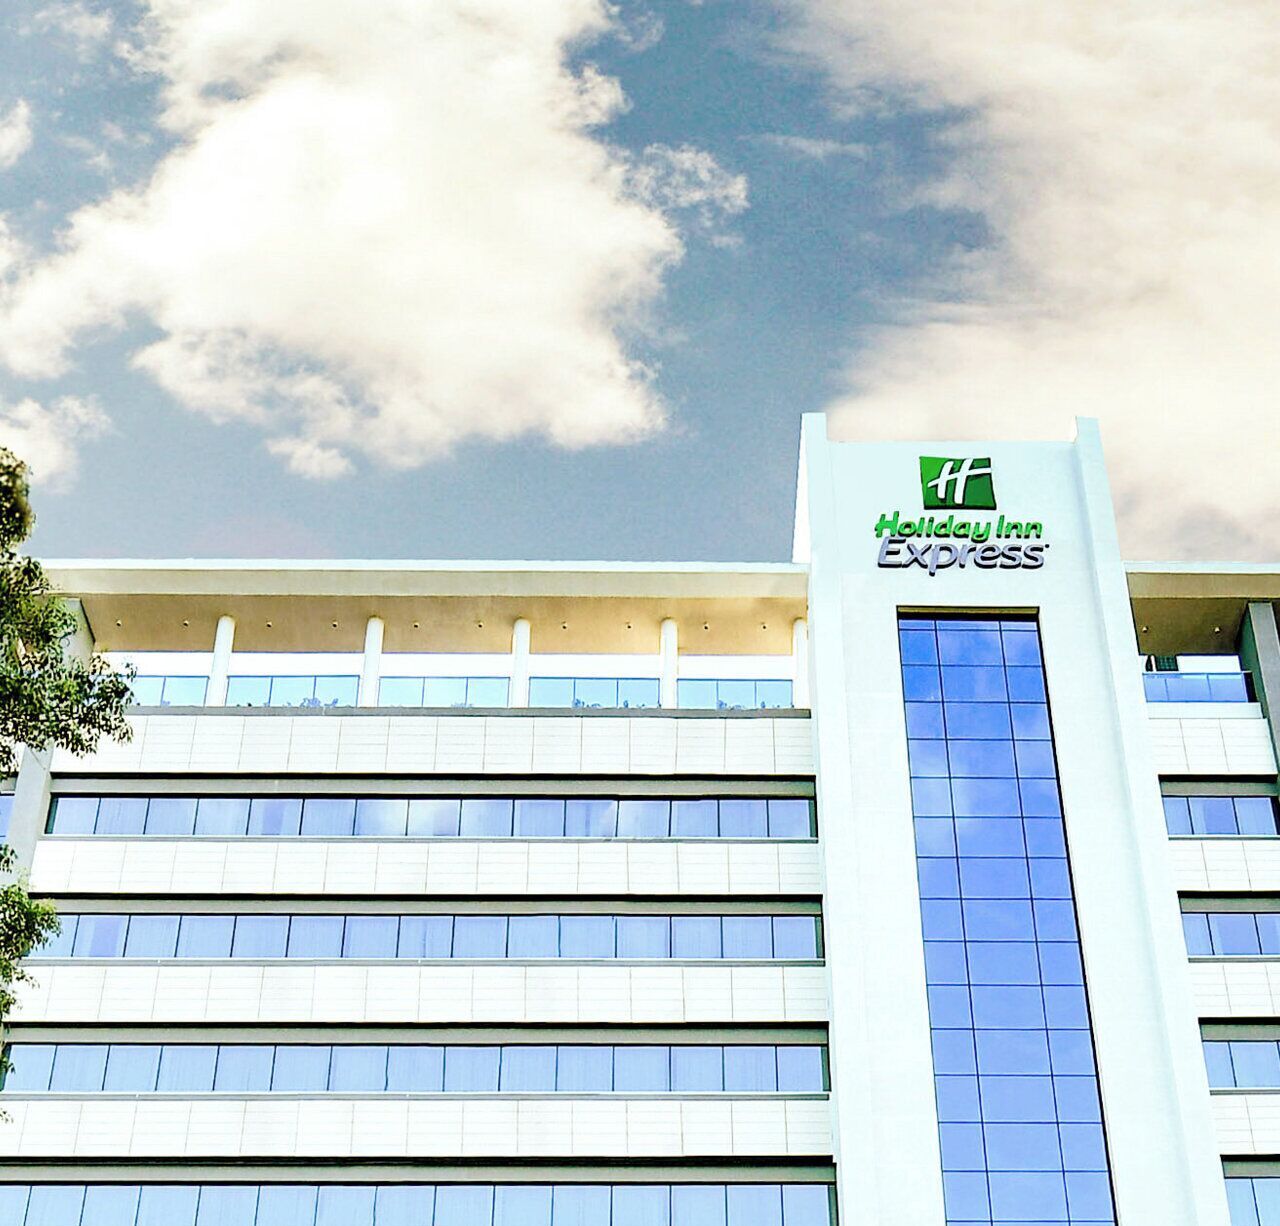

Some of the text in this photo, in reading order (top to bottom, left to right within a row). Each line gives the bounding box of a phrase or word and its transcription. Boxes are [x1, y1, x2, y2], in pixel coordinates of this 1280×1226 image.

[874, 511, 1043, 543] Holiday Inn
[876, 536, 1045, 577] Express
